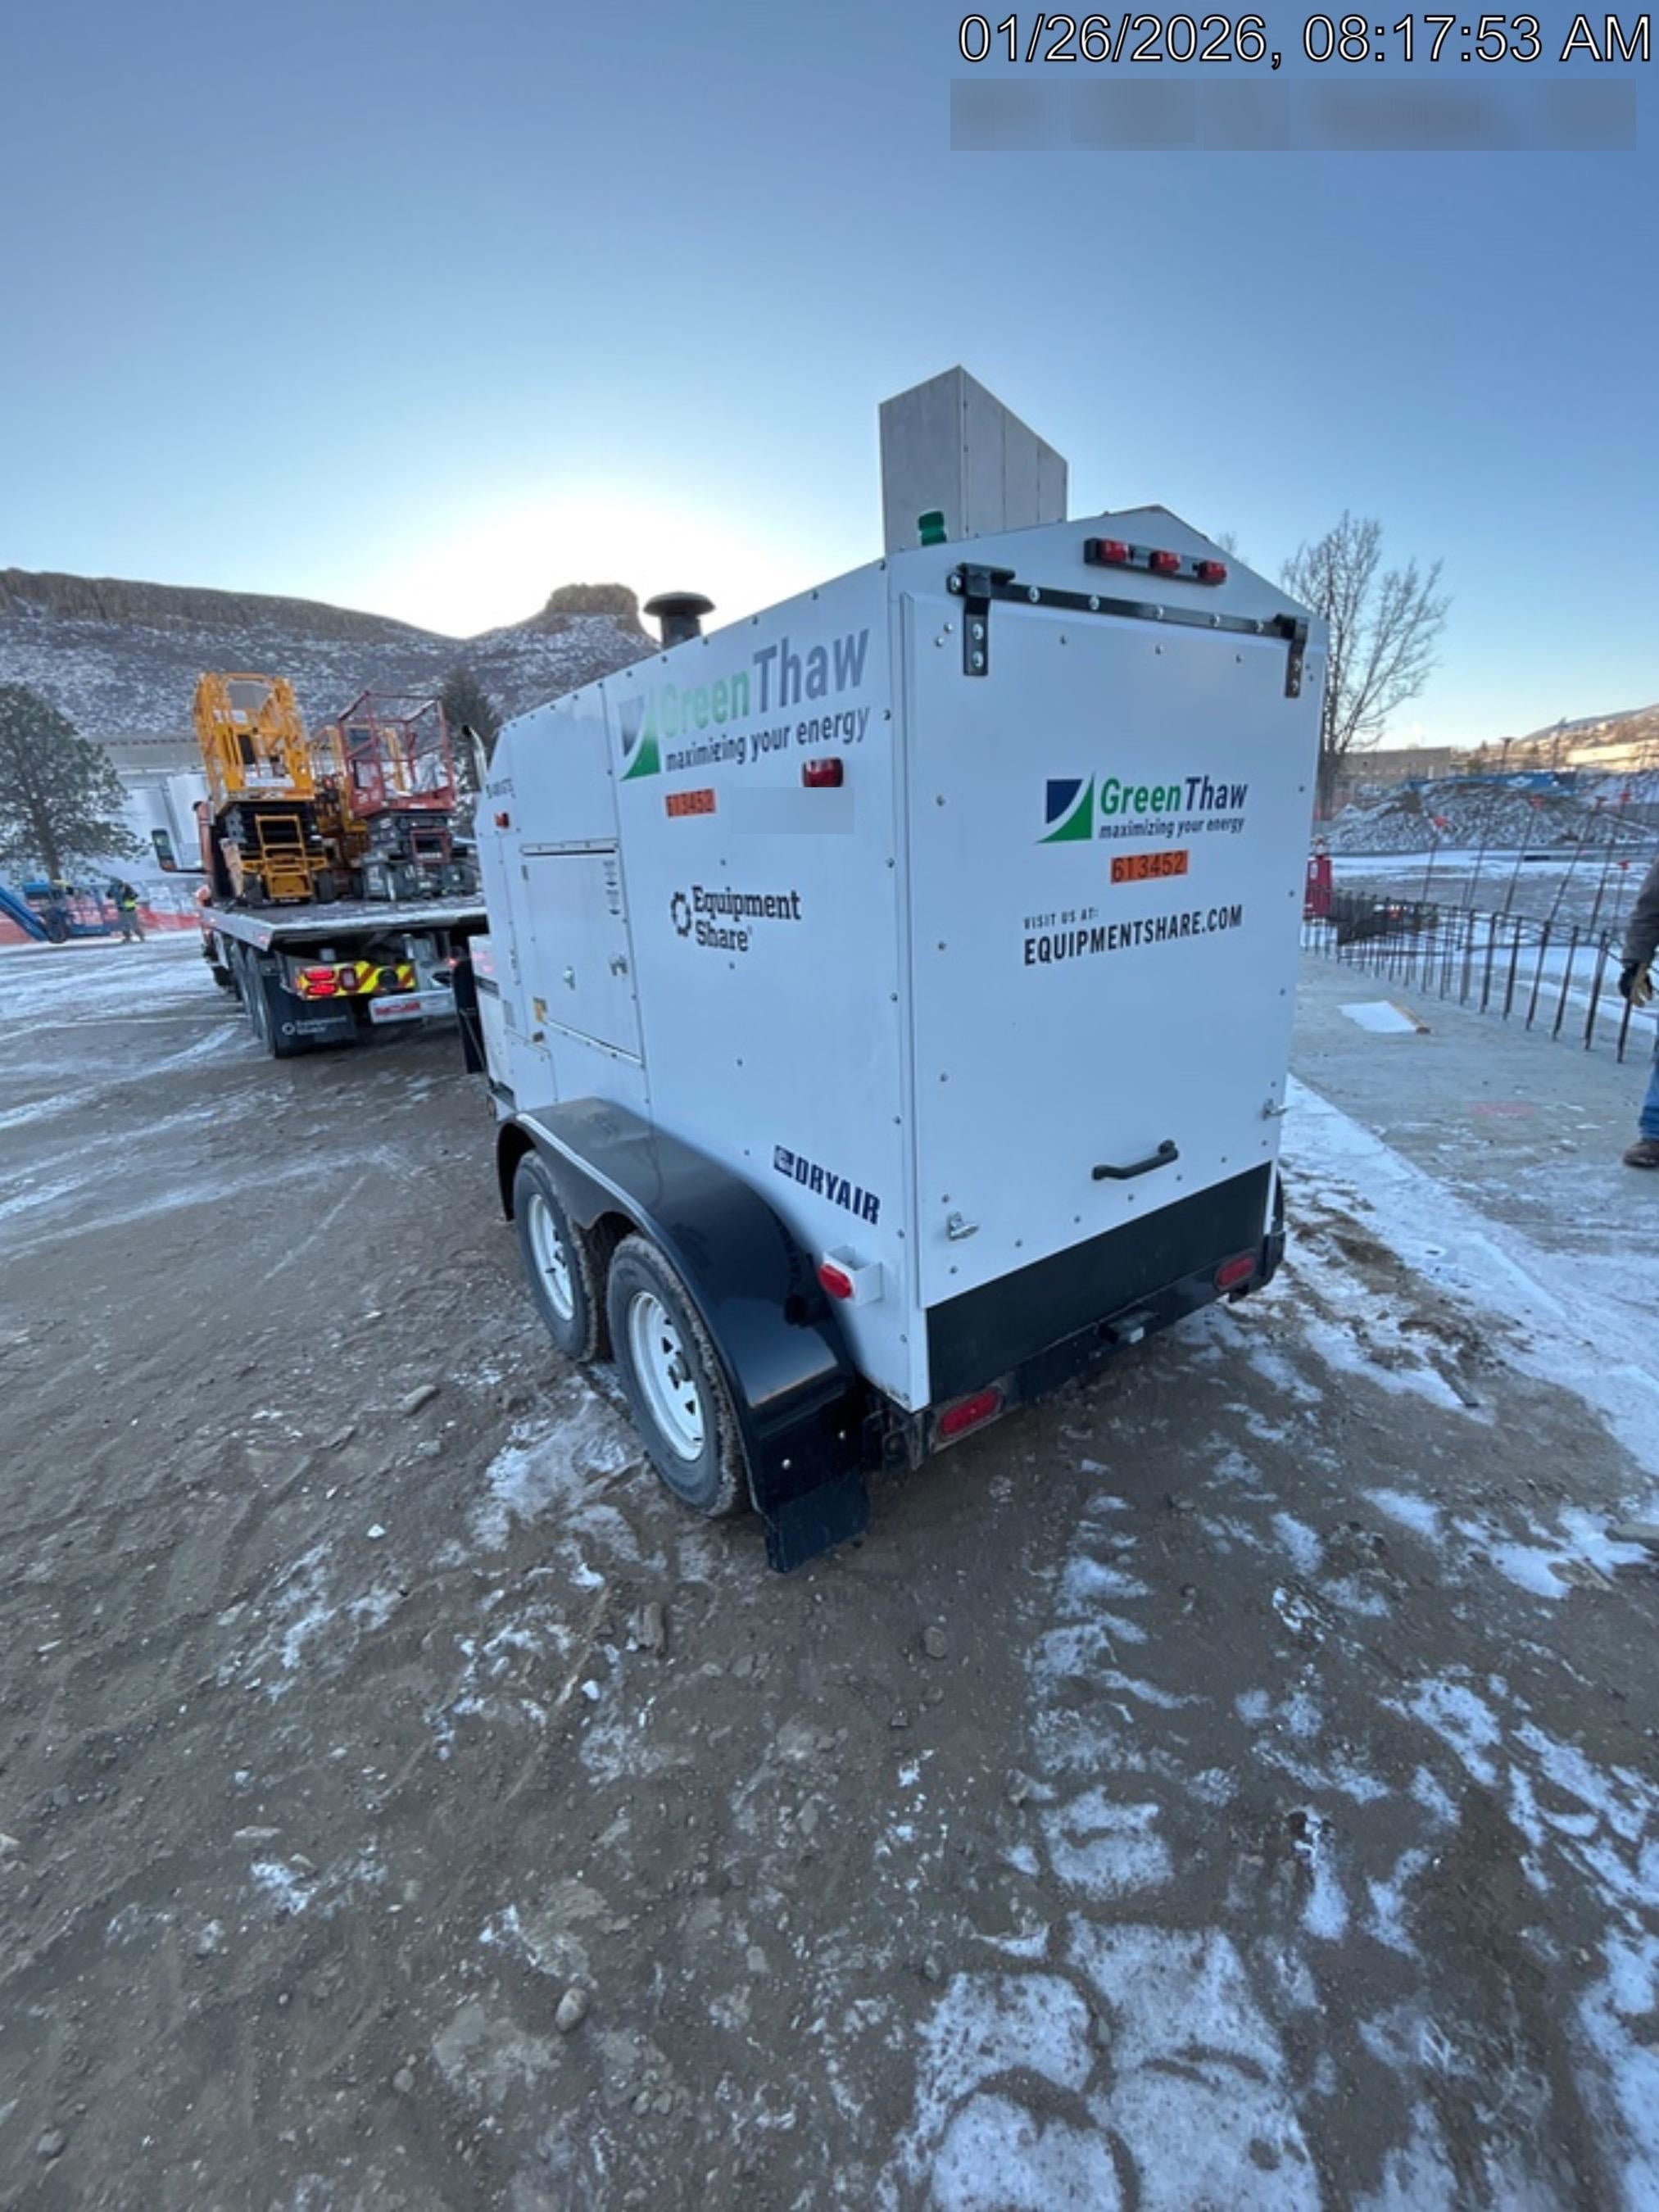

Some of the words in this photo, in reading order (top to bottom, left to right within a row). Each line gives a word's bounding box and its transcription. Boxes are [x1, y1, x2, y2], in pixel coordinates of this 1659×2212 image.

[665, 734, 746, 772] maximizing
[750, 724, 791, 762] your
[796, 707, 870, 746] energy
[1100, 775, 1248, 815] GreenThaw
[1099, 819, 1173, 840] maximizing
[1177, 821, 1203, 837] your
[1207, 818, 1245, 835] energy
[1112, 852, 1187, 882] 613452
[692, 885, 801, 922] Equipment
[1023, 913, 1056, 930] VISIT
[1061, 909, 1075, 923] US
[1024, 904, 1243, 966] EQUIPMENTSHARE.COM
[796, 1156, 881, 1225] DRYAIR
